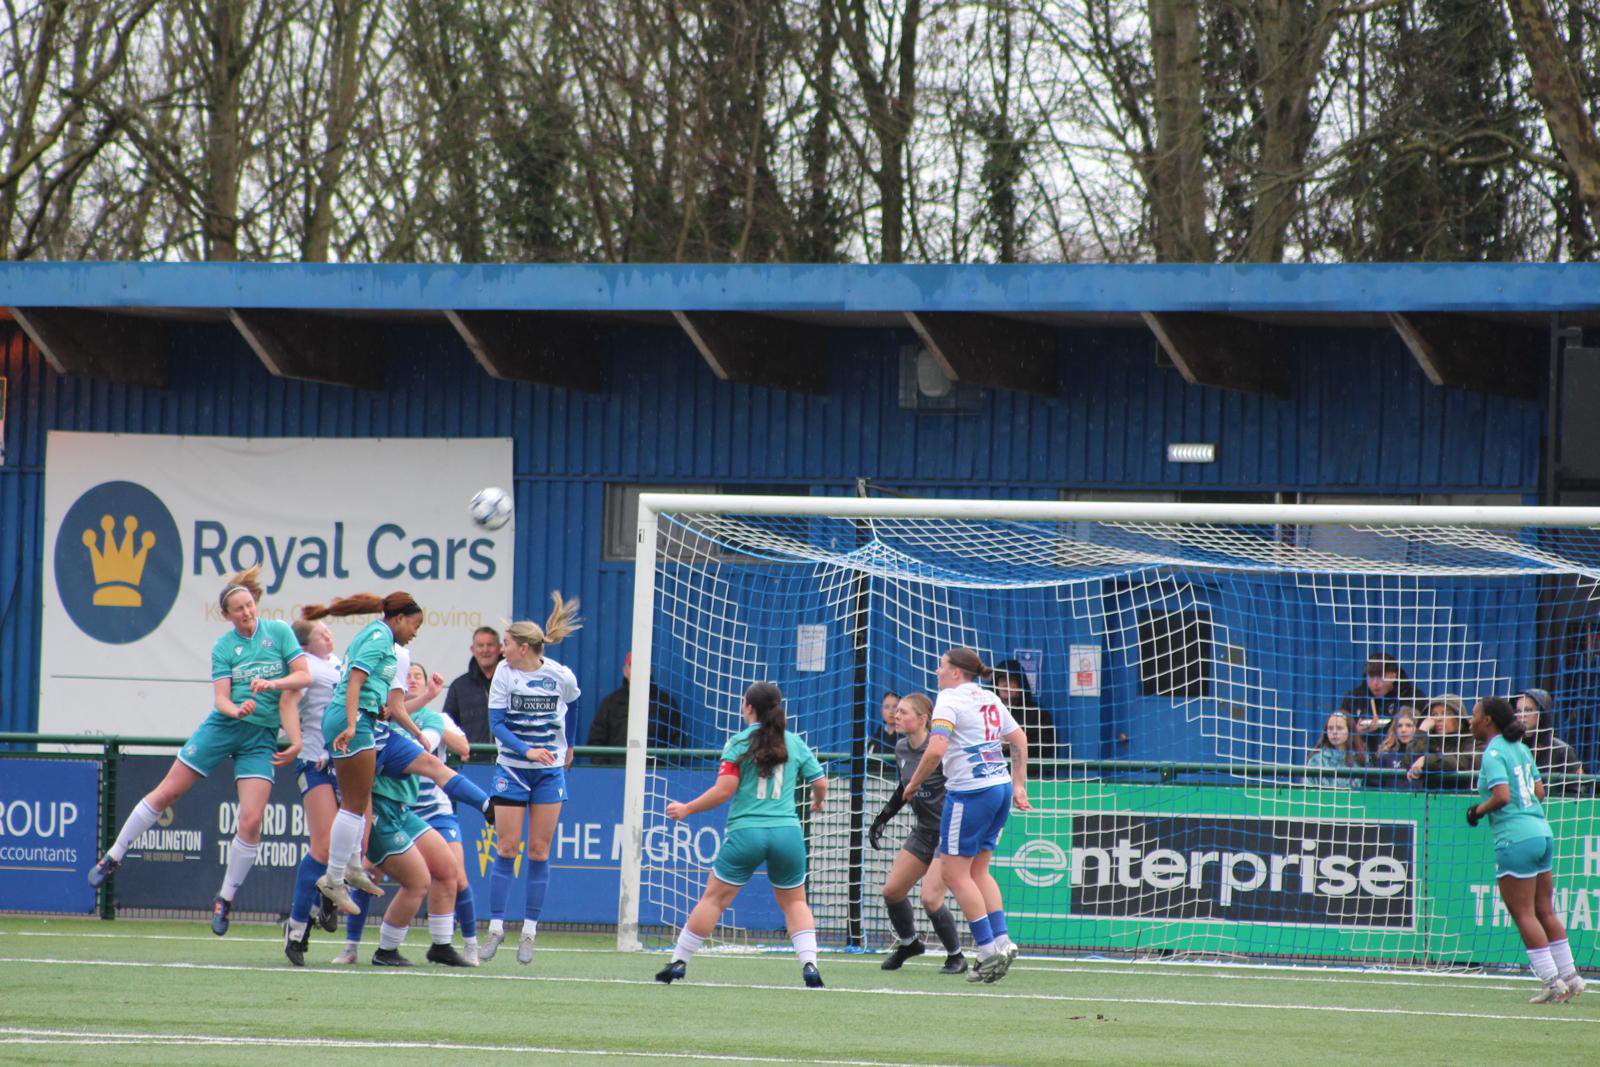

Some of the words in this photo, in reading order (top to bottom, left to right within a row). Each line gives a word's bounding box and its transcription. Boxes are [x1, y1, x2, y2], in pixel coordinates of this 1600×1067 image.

[193, 520, 349, 594] Royal
[366, 523, 497, 581] Cars
[423, 607, 482, 627] oving
[523, 702, 556, 710] OXFORD
[979, 704, 1001, 741] 19
[757, 764, 784, 800] 11
[0, 800, 77, 838] OUP
[219, 802, 287, 836] OXRD
[255, 842, 297, 867] XFORD
[1013, 838, 1407, 907] enterprise
